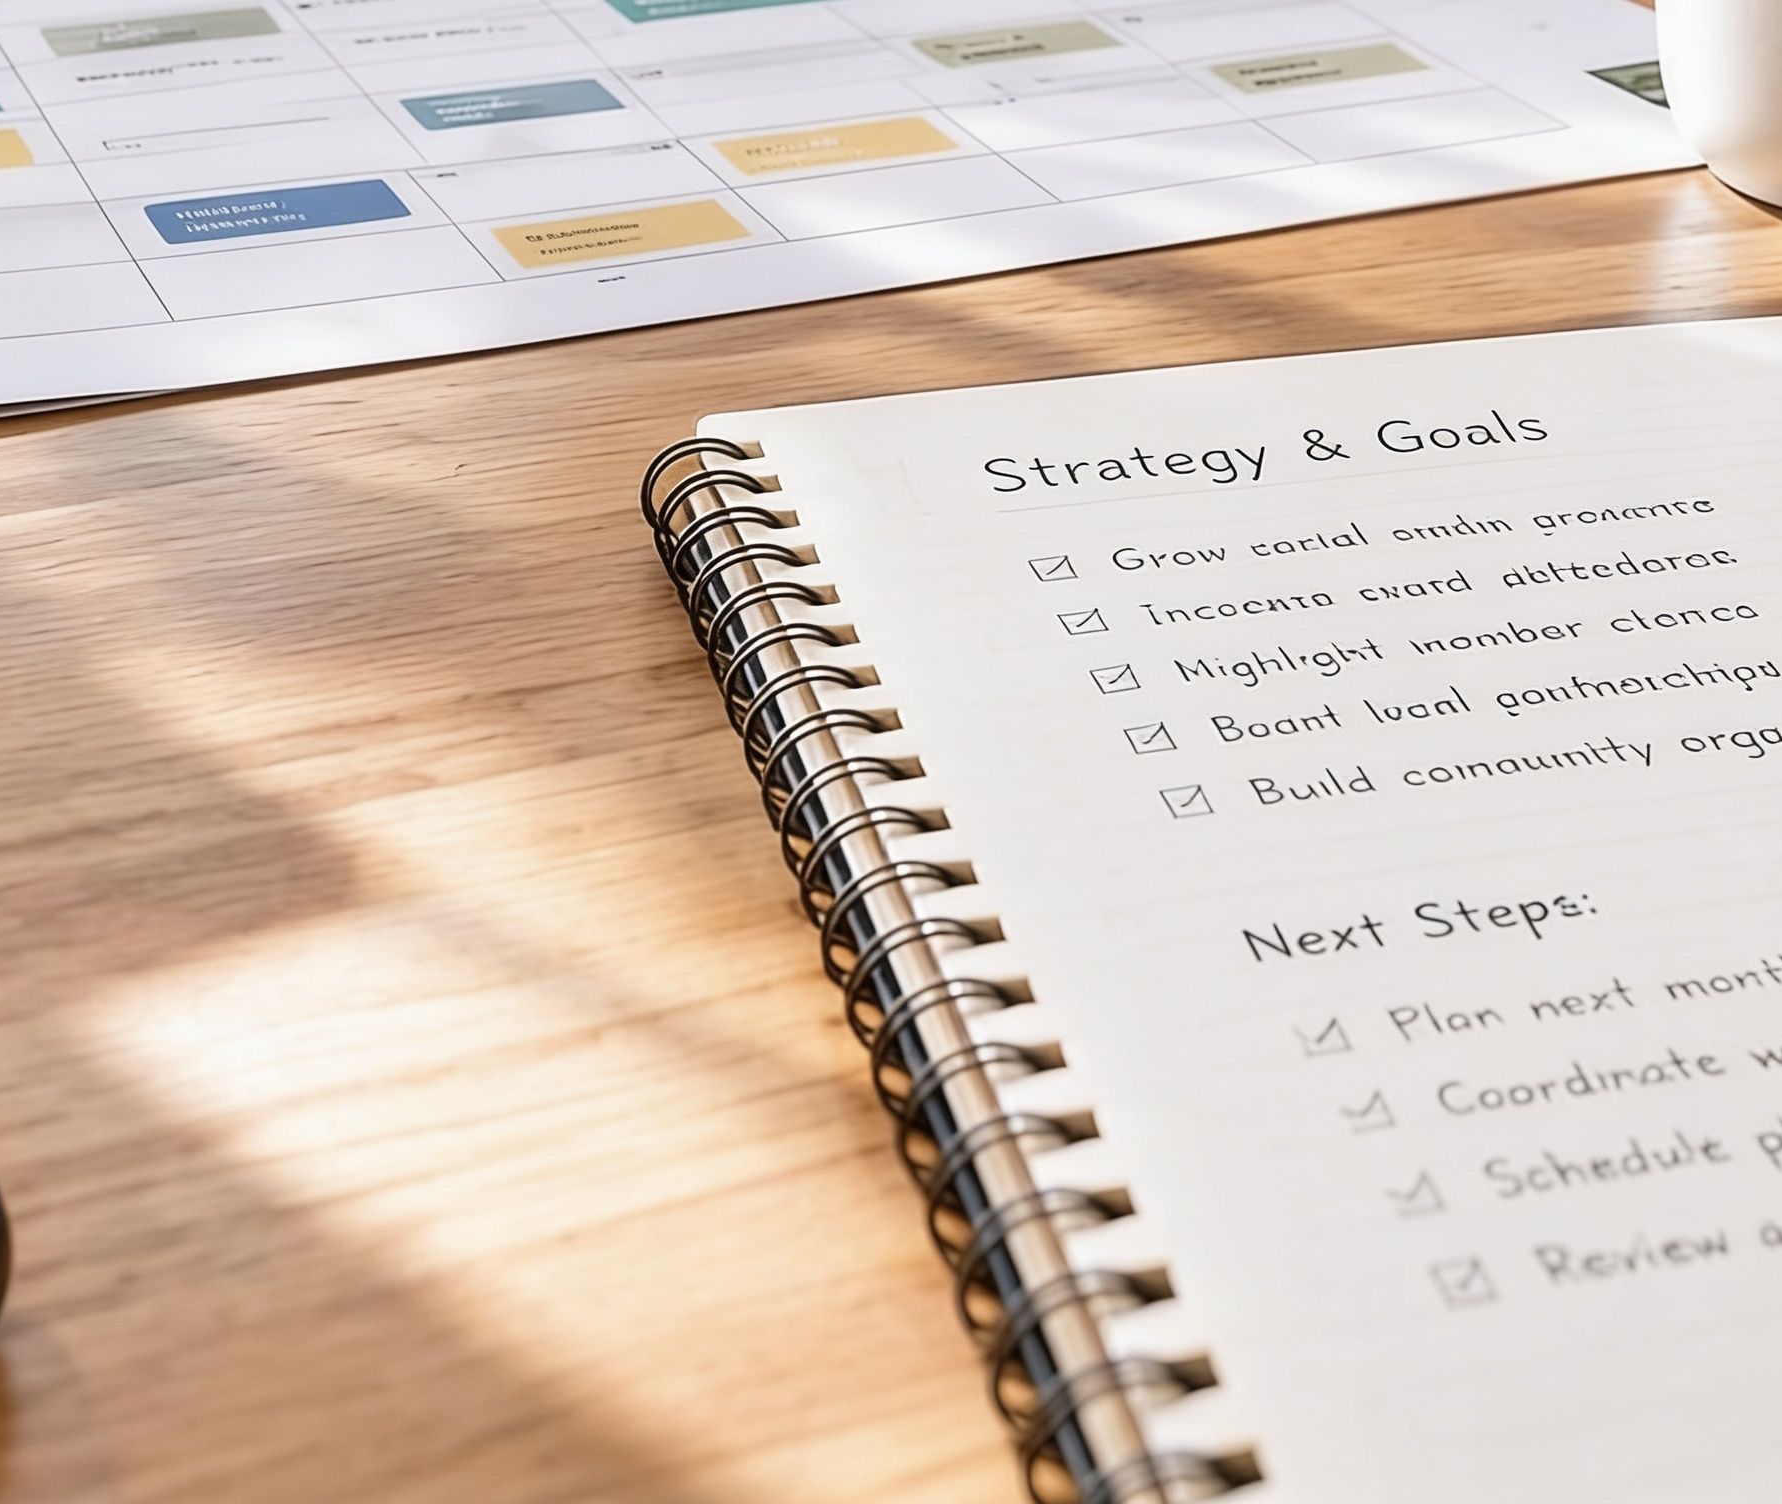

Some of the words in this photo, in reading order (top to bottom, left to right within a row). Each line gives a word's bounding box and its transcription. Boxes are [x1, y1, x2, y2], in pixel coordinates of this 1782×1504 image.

[985, 443, 1265, 492] Strategy
[1303, 430, 1351, 461] &
[1378, 410, 1547, 452] Goals
[1113, 548, 1225, 570] Grow
[1249, 766, 1376, 805] Build
[1242, 915, 1384, 962] Next
[1415, 894, 1596, 940] Steps:
[1388, 1003, 1503, 1041] Plan
[1530, 978, 1634, 1020] next
